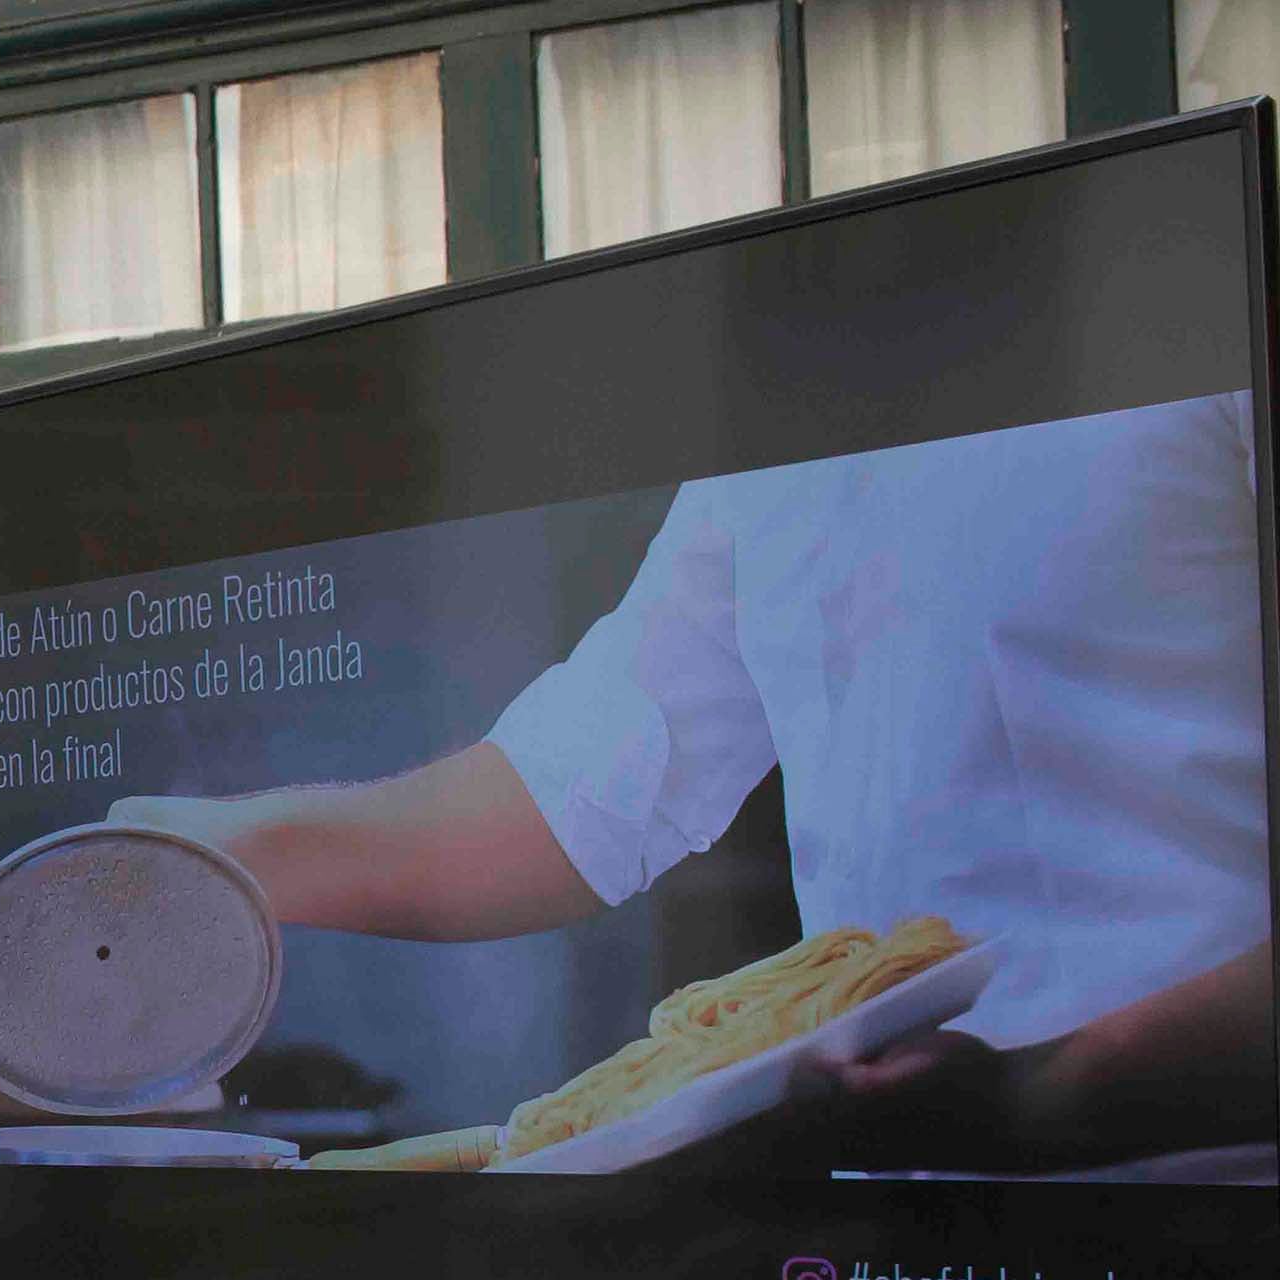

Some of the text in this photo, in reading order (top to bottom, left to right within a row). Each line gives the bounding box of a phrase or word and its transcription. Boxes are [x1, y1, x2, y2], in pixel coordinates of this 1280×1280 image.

[30, 600, 93, 654] Atún
[102, 606, 118, 643] o
[127, 589, 213, 640] Carne
[223, 564, 336, 625] Retinta
[46, 658, 185, 728] productos
[195, 648, 229, 699] de
[240, 643, 265, 693] la
[274, 629, 363, 692] Janda
[32, 737, 54, 785] la
[62, 727, 122, 782] final
